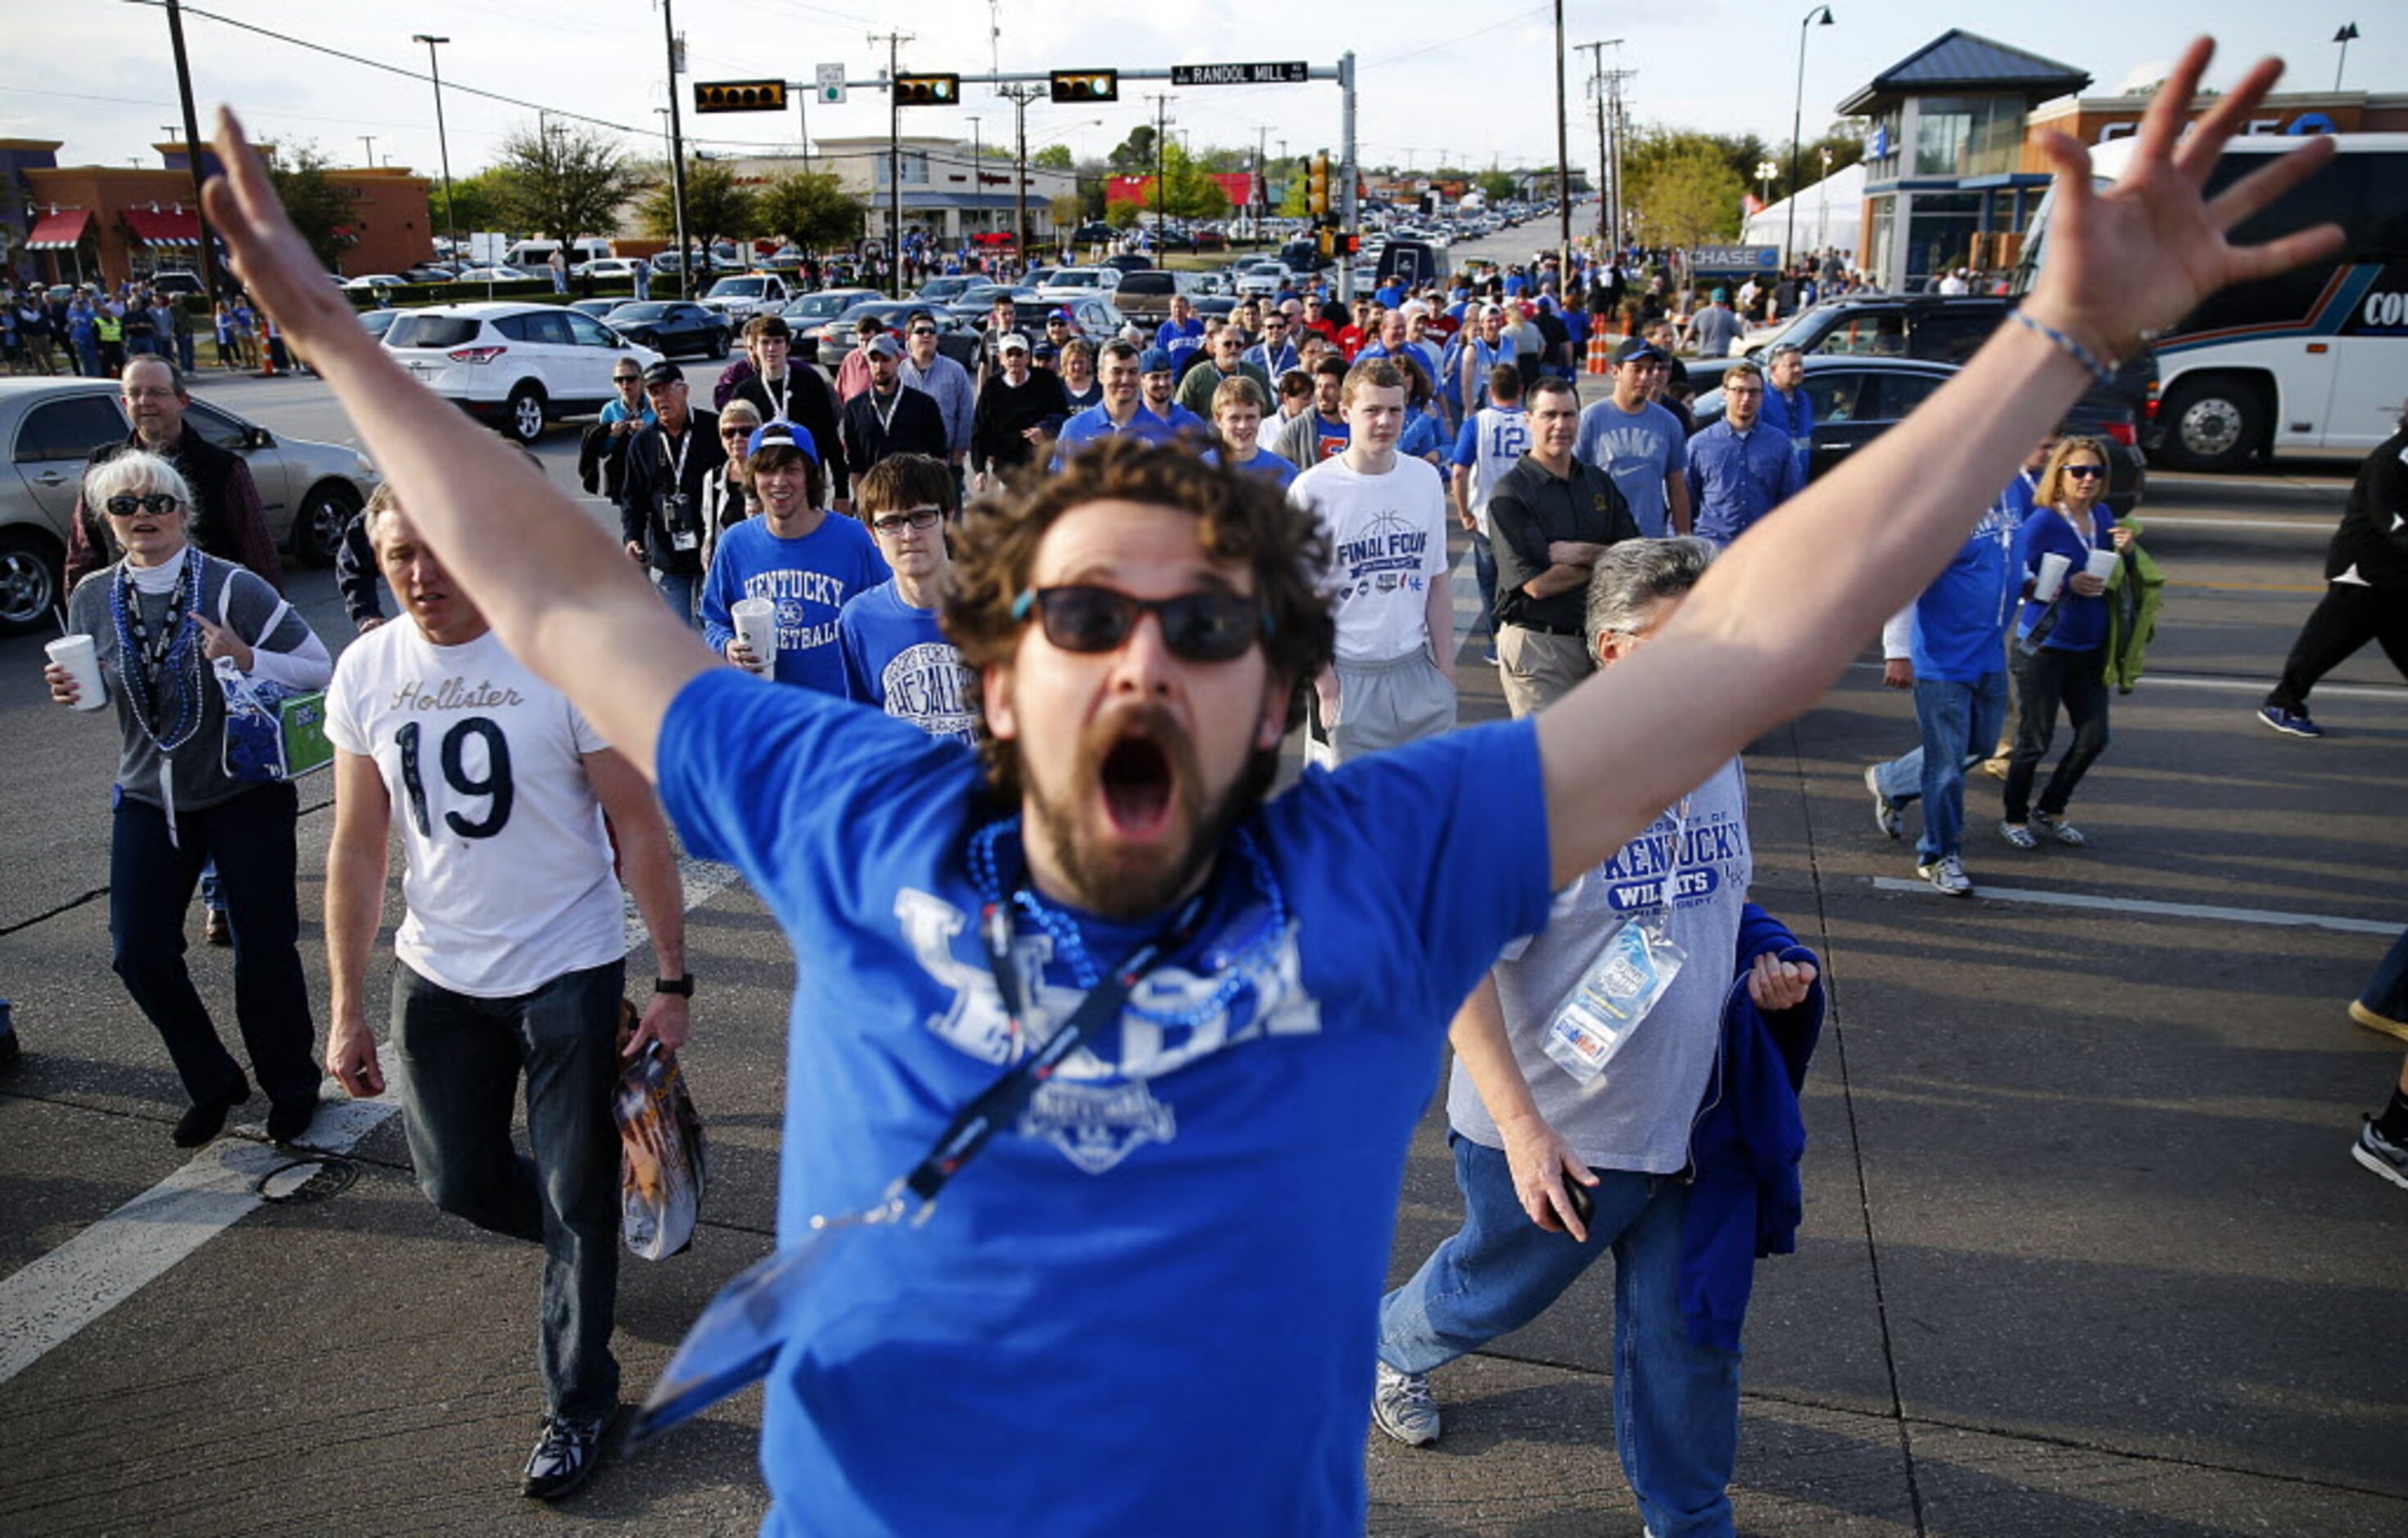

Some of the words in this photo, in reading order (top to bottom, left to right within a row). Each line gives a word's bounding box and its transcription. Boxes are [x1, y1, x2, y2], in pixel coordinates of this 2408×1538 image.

[1193, 66, 1249, 83] RANDOL
[1255, 65, 1286, 81] MILL
[1688, 251, 1756, 265] CHASE
[1492, 425, 1524, 458] 12
[1338, 536, 1384, 567] FINAL
[745, 569, 844, 608] KENTUCKY
[391, 676, 524, 712] Hollister
[395, 717, 514, 839] 19
